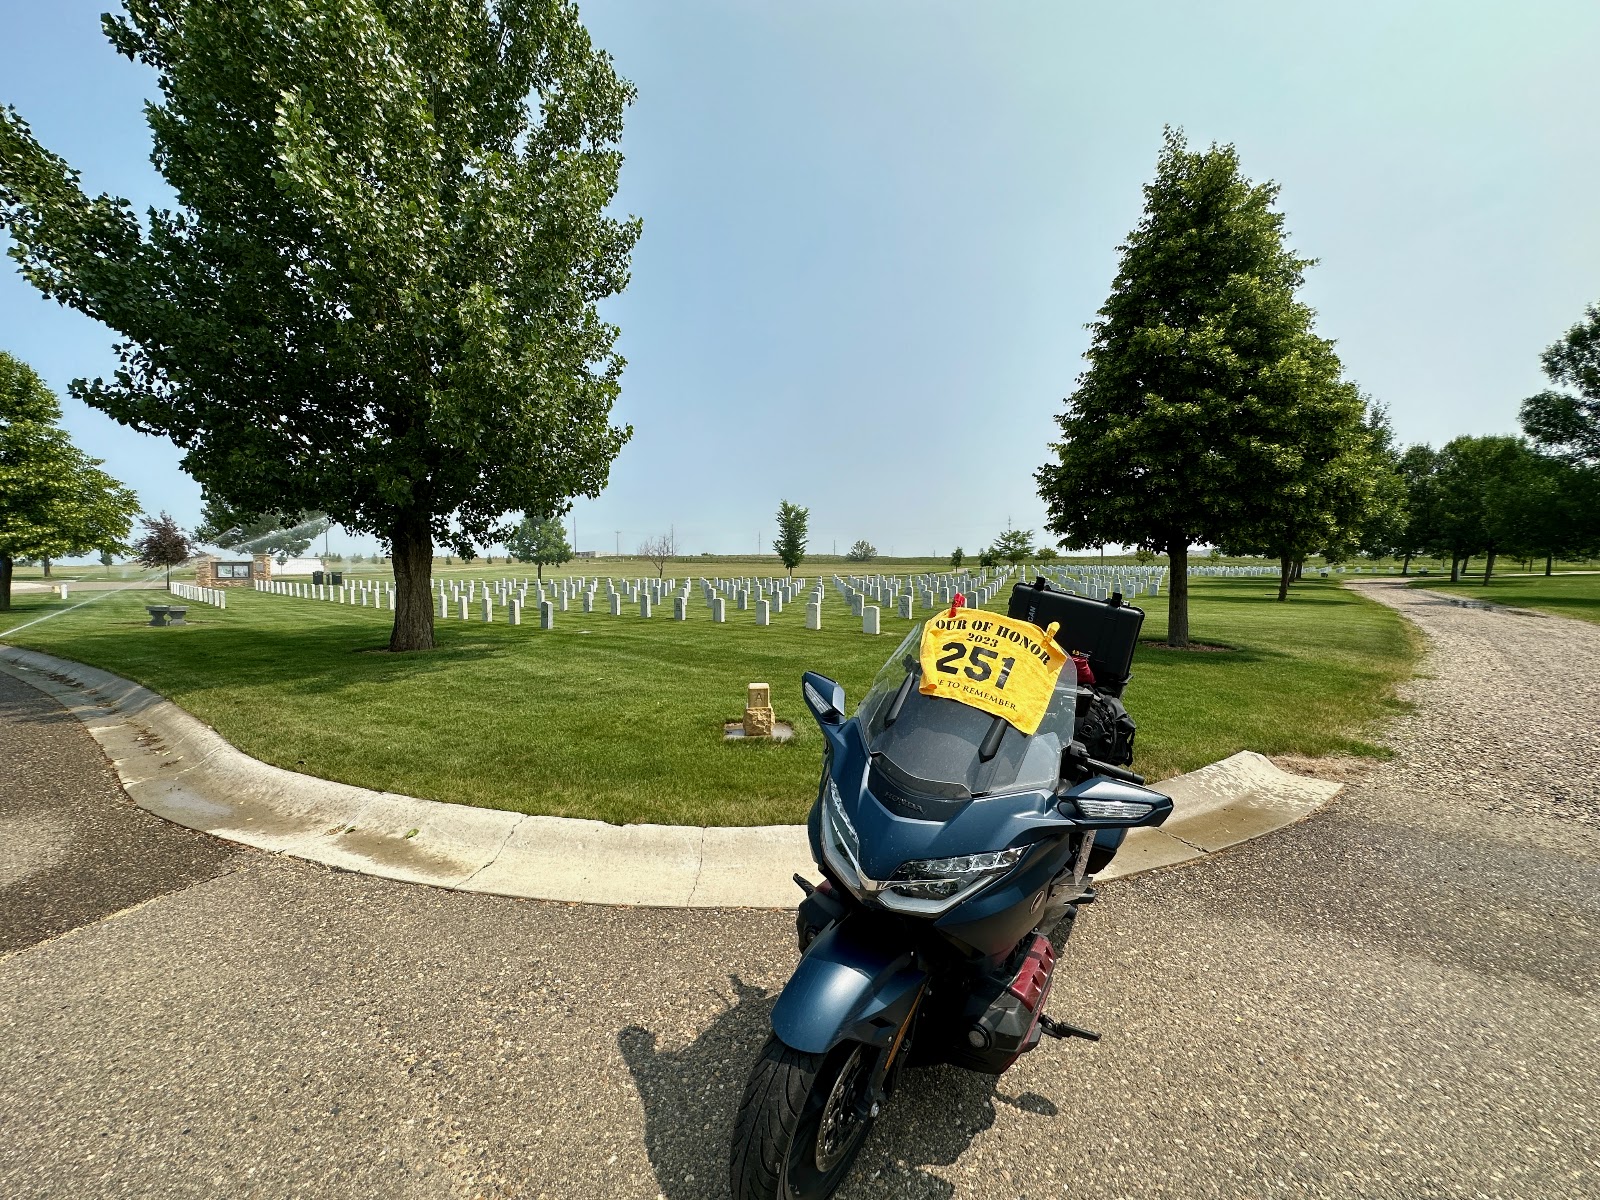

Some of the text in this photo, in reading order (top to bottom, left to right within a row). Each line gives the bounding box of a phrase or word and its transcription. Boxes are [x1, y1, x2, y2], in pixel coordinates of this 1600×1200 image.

[966, 632, 999, 648] 2023
[971, 619, 994, 633] OF
[995, 624, 1051, 665] HONOR
[935, 641, 1016, 690] 251
[755, 692, 763, 703] A
[947, 680, 960, 689] TO
[962, 685, 1018, 712] REMEMBER.
[884, 791, 924, 814] HONDA
